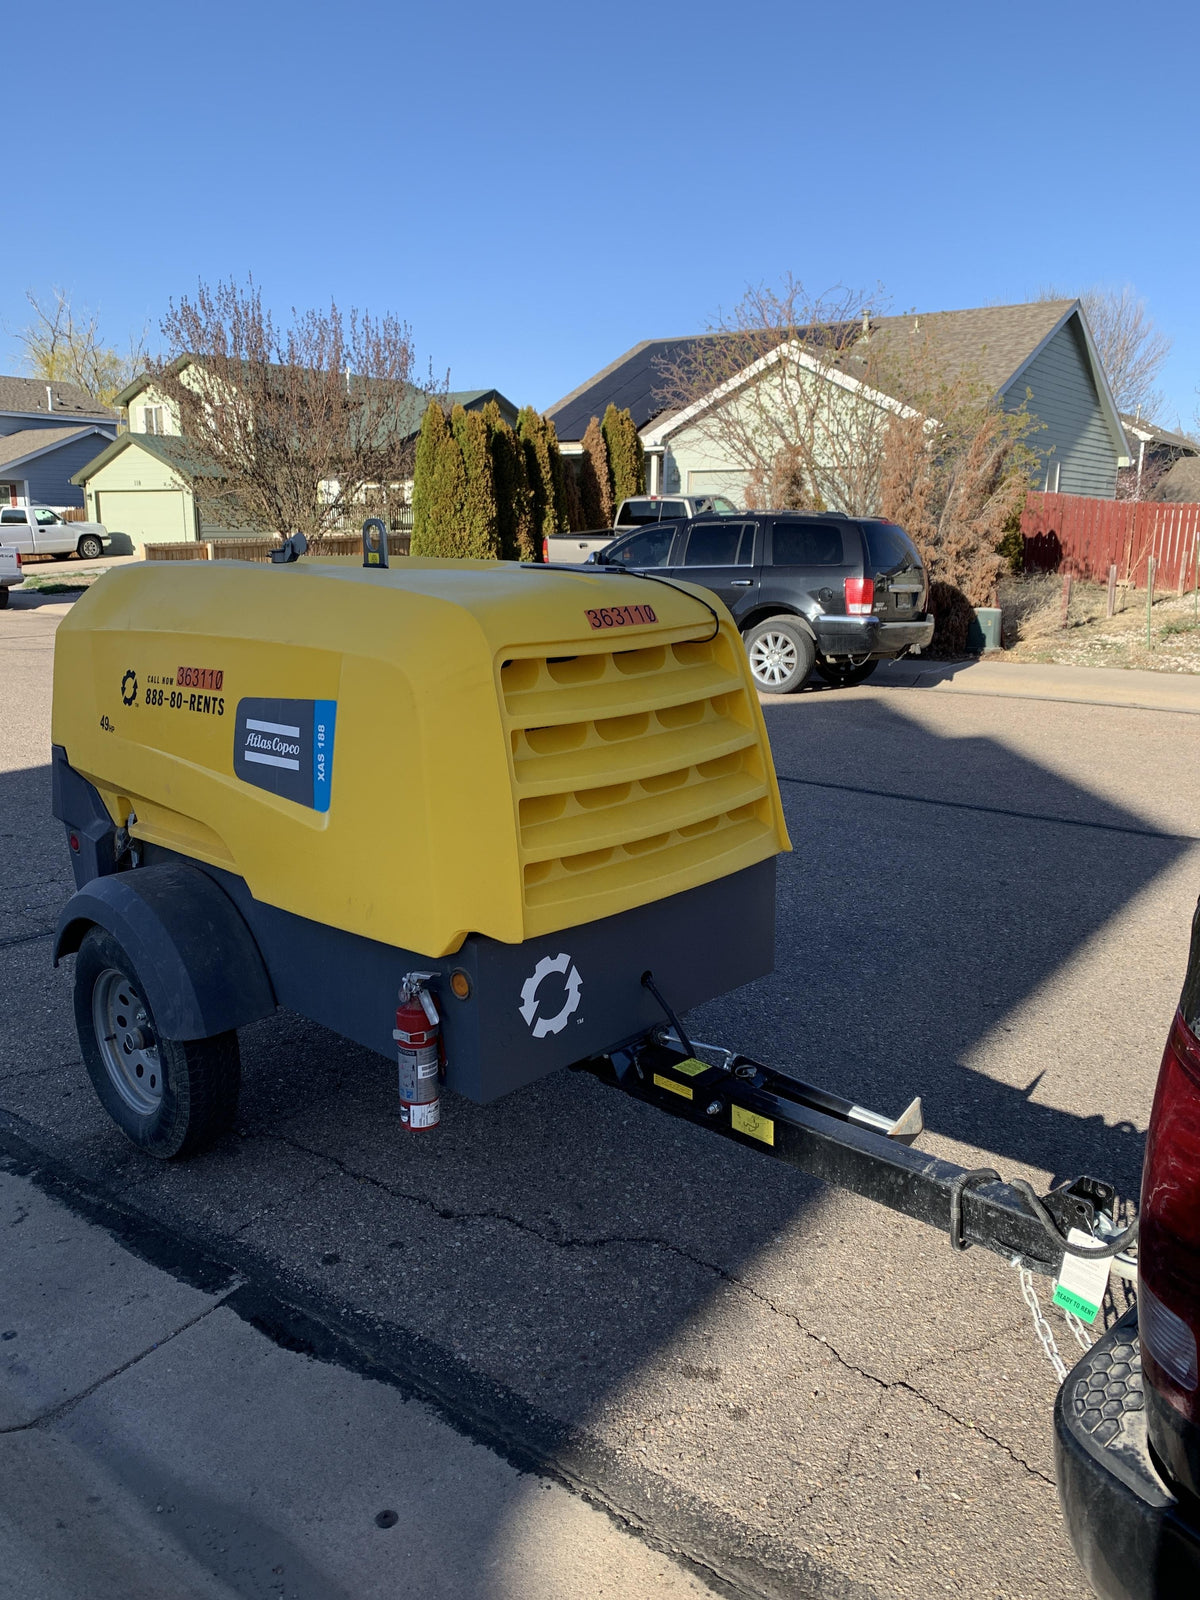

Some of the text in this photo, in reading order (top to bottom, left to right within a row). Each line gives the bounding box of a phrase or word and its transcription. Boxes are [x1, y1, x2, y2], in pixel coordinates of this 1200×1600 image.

[587, 604, 657, 628] 363110
[147, 675, 174, 686] CALL NOW
[177, 666, 223, 690] 363110
[145, 688, 225, 716] 888-80-RENTS
[317, 724, 326, 782] XAS 188
[1056, 1291, 1095, 1317] READY TO RENT
